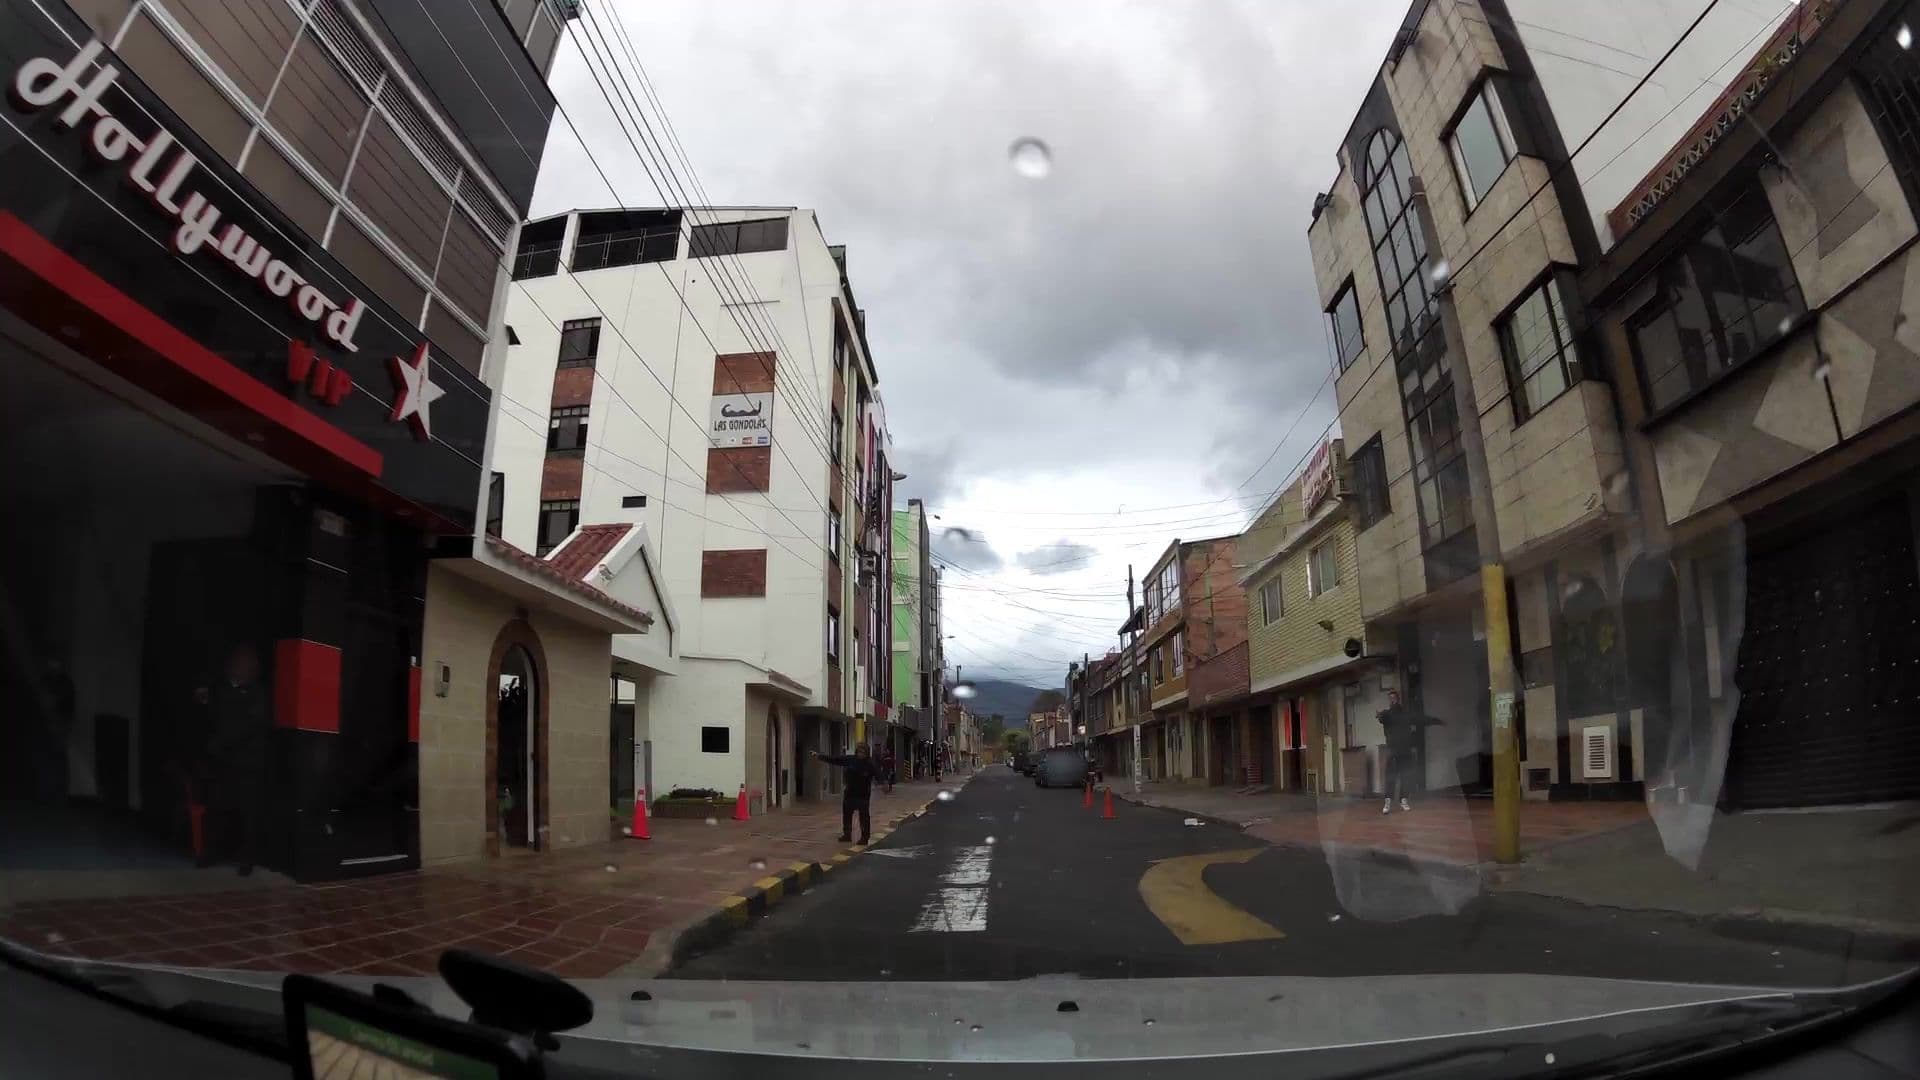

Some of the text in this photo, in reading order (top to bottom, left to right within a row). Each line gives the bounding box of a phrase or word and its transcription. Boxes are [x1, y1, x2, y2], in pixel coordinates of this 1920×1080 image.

[15, 39, 366, 353] Hollywood
[288, 337, 352, 405] VIP
[714, 418, 766, 432] LAS GONDOLAS
